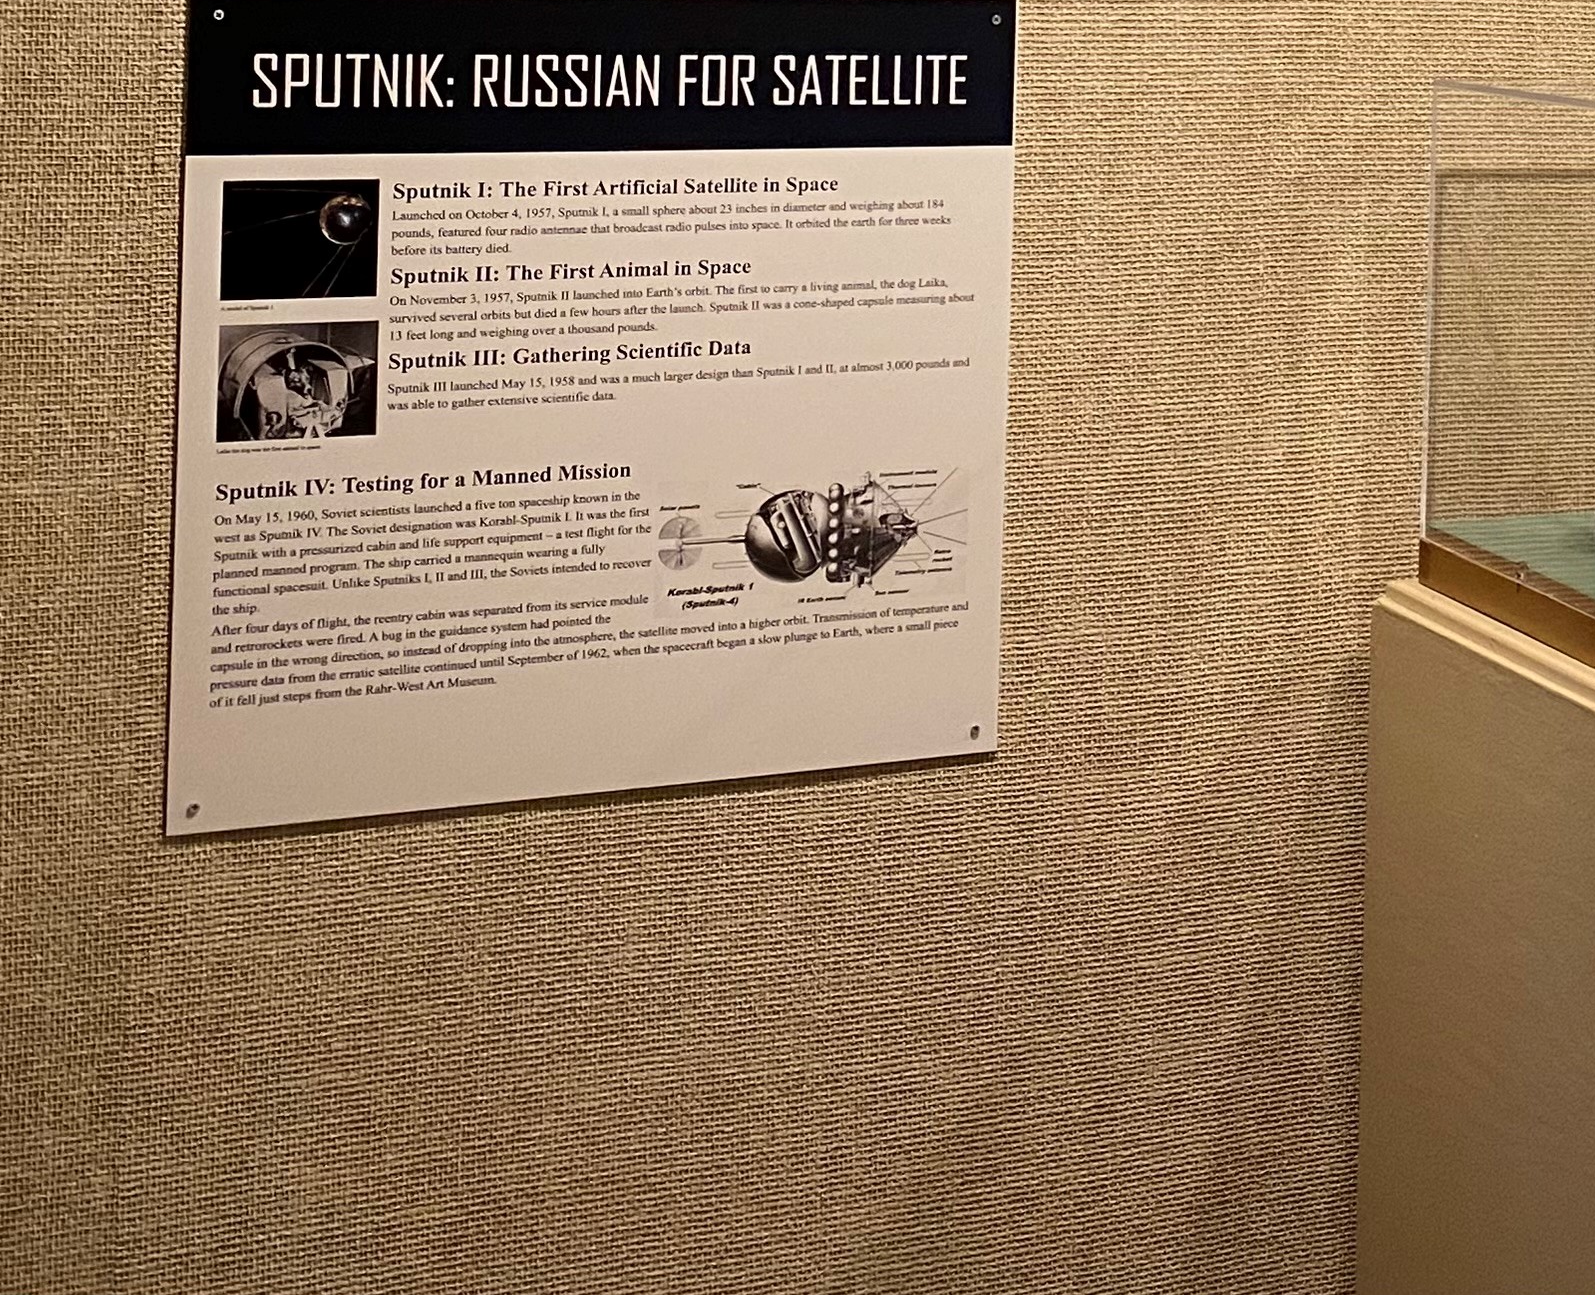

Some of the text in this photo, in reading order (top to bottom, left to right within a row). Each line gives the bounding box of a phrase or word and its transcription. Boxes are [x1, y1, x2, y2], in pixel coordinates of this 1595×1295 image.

[252, 53, 968, 108] SPUTNIK: RUSSIAN FOR SATELLITE
[392, 176, 838, 203] Sputnik I: The First Artificial Satellite in Space
[390, 243, 511, 256] before its battery died.
[390, 259, 751, 288] Sputnik II: The First Animal in Space
[388, 340, 751, 373] Sputnik III: Gathering Scientific Data
[215, 463, 630, 504] Sputnik IV: Testing for a Manned Mission
[212, 603, 259, 615] the ship.
